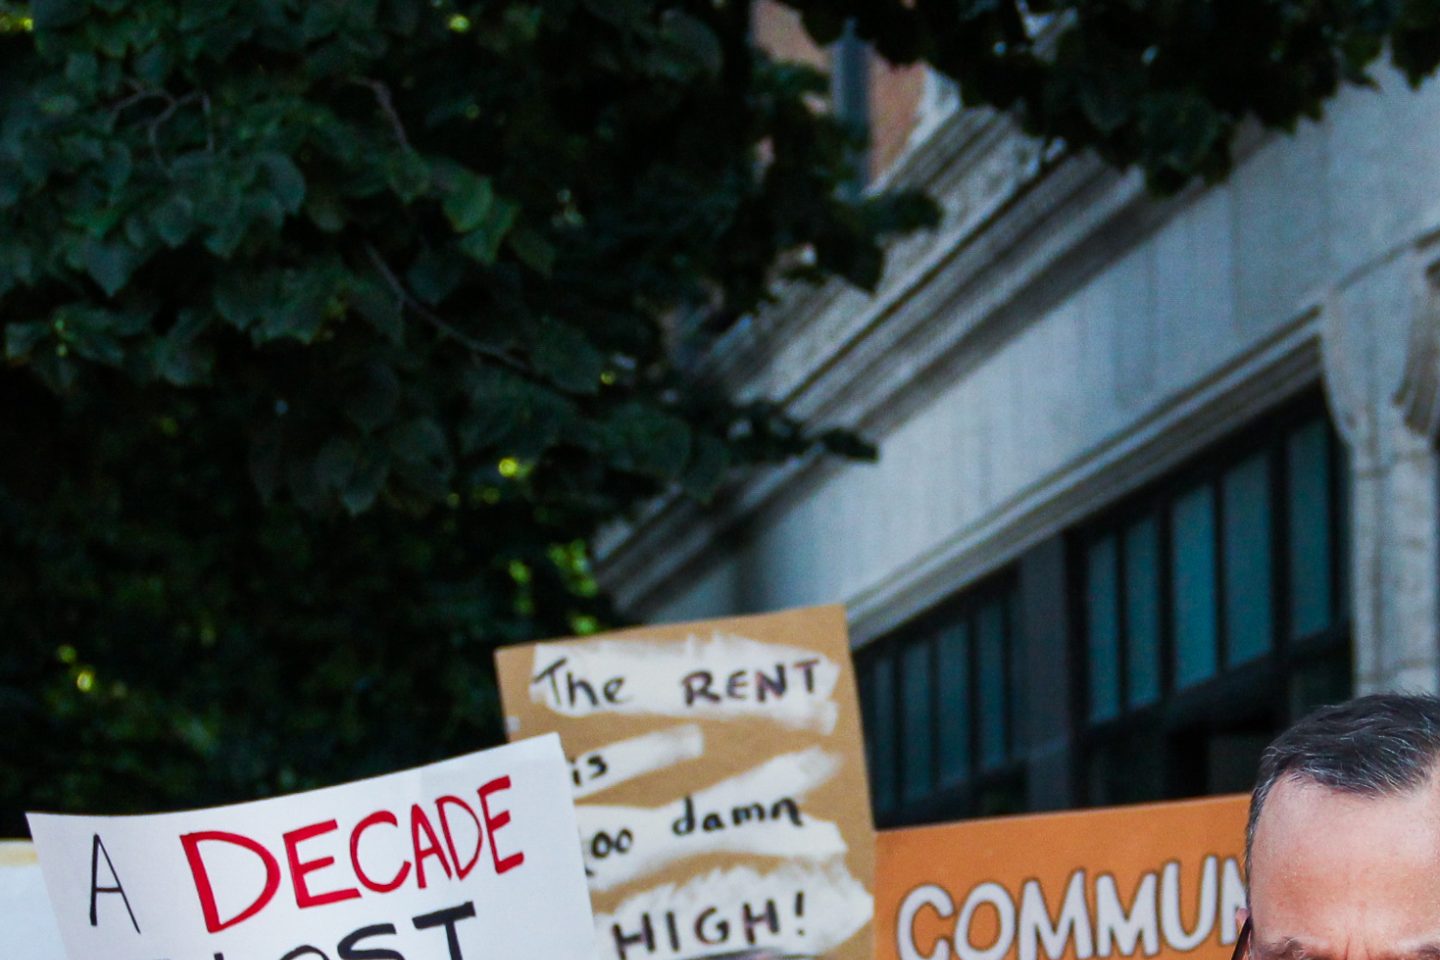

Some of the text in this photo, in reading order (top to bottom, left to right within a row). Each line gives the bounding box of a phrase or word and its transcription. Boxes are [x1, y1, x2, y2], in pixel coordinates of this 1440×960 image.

[533, 658, 820, 707] The RENT
[569, 755, 607, 786] is
[89, 775, 525, 934] A DECADE
[585, 797, 803, 877] oo damn
